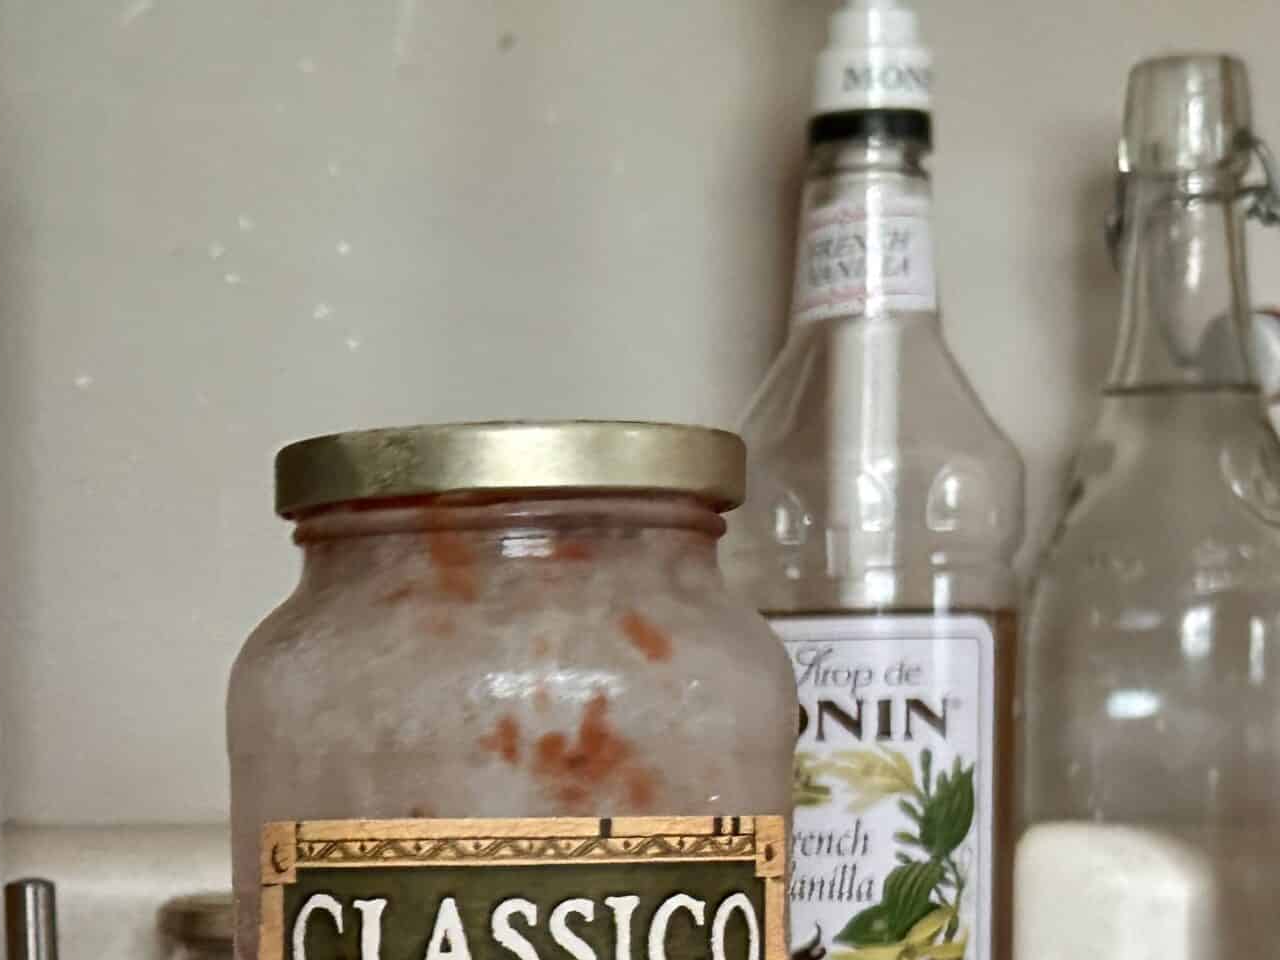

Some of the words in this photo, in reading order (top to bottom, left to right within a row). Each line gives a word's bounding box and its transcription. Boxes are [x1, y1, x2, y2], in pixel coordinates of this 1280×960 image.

[799, 697, 947, 741] NIN
[792, 818, 869, 857] rench
[790, 860, 874, 902] anilla
